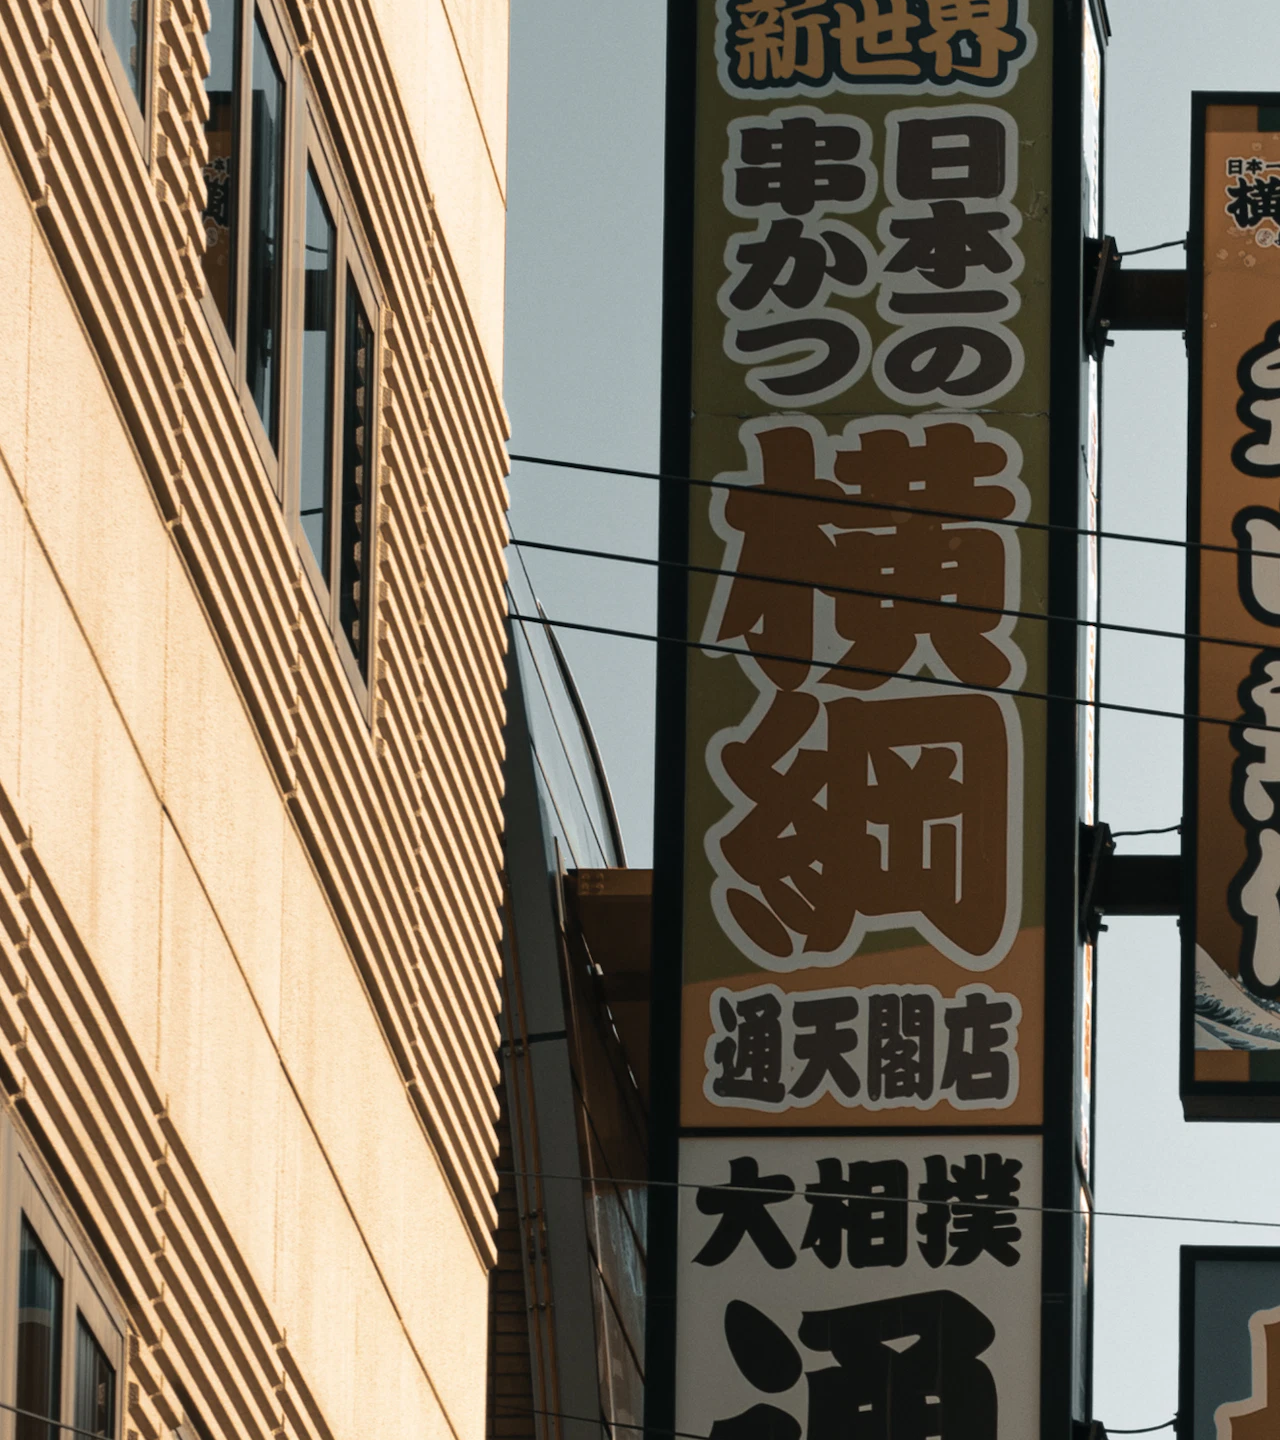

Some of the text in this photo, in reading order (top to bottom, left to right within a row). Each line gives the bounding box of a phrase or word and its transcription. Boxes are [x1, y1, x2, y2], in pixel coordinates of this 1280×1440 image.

[732, 116, 864, 398] 串かつ
[885, 116, 1012, 398] 日本一の
[714, 422, 1016, 959] 横綱
[711, 992, 1013, 1107] 通天閣店
[693, 1154, 1023, 1269] 大相撲
